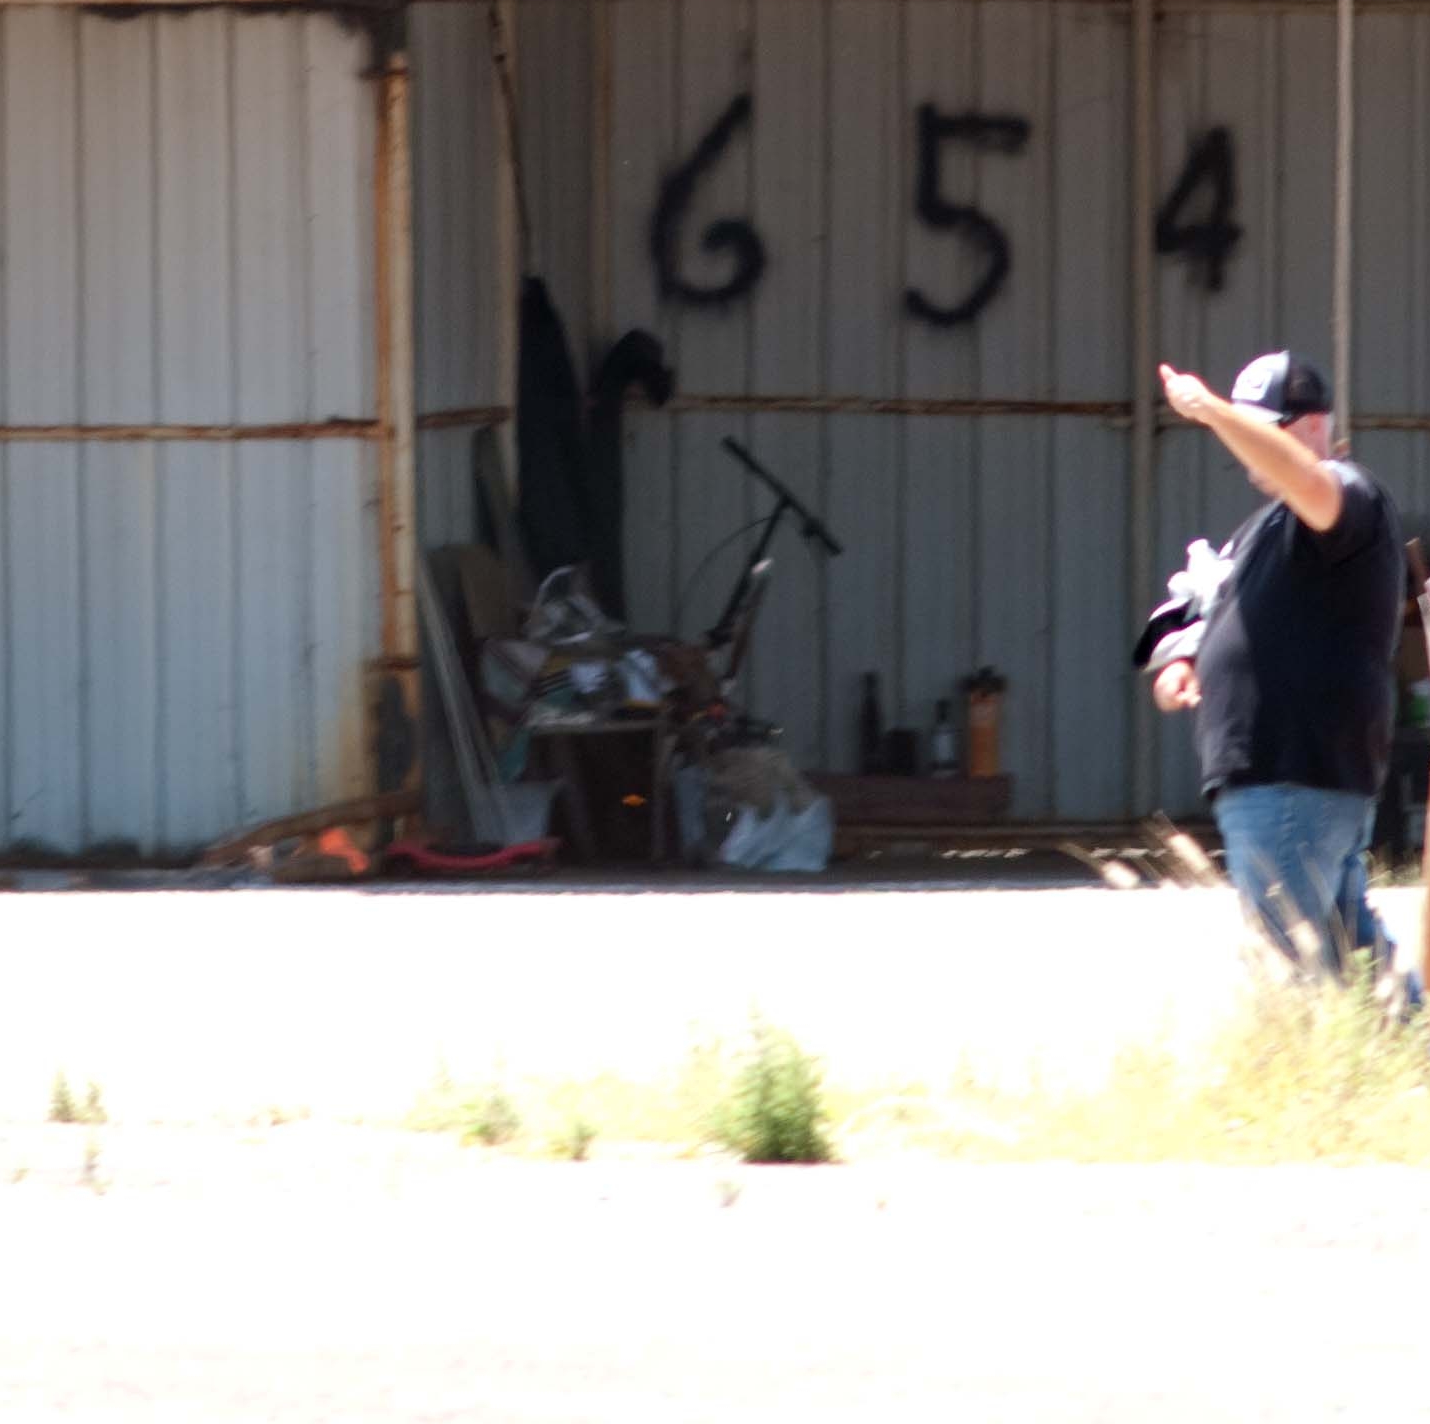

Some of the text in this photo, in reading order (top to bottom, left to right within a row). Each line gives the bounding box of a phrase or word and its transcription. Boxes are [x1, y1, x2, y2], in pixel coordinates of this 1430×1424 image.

[649, 92, 1241, 328] 6 5 4
